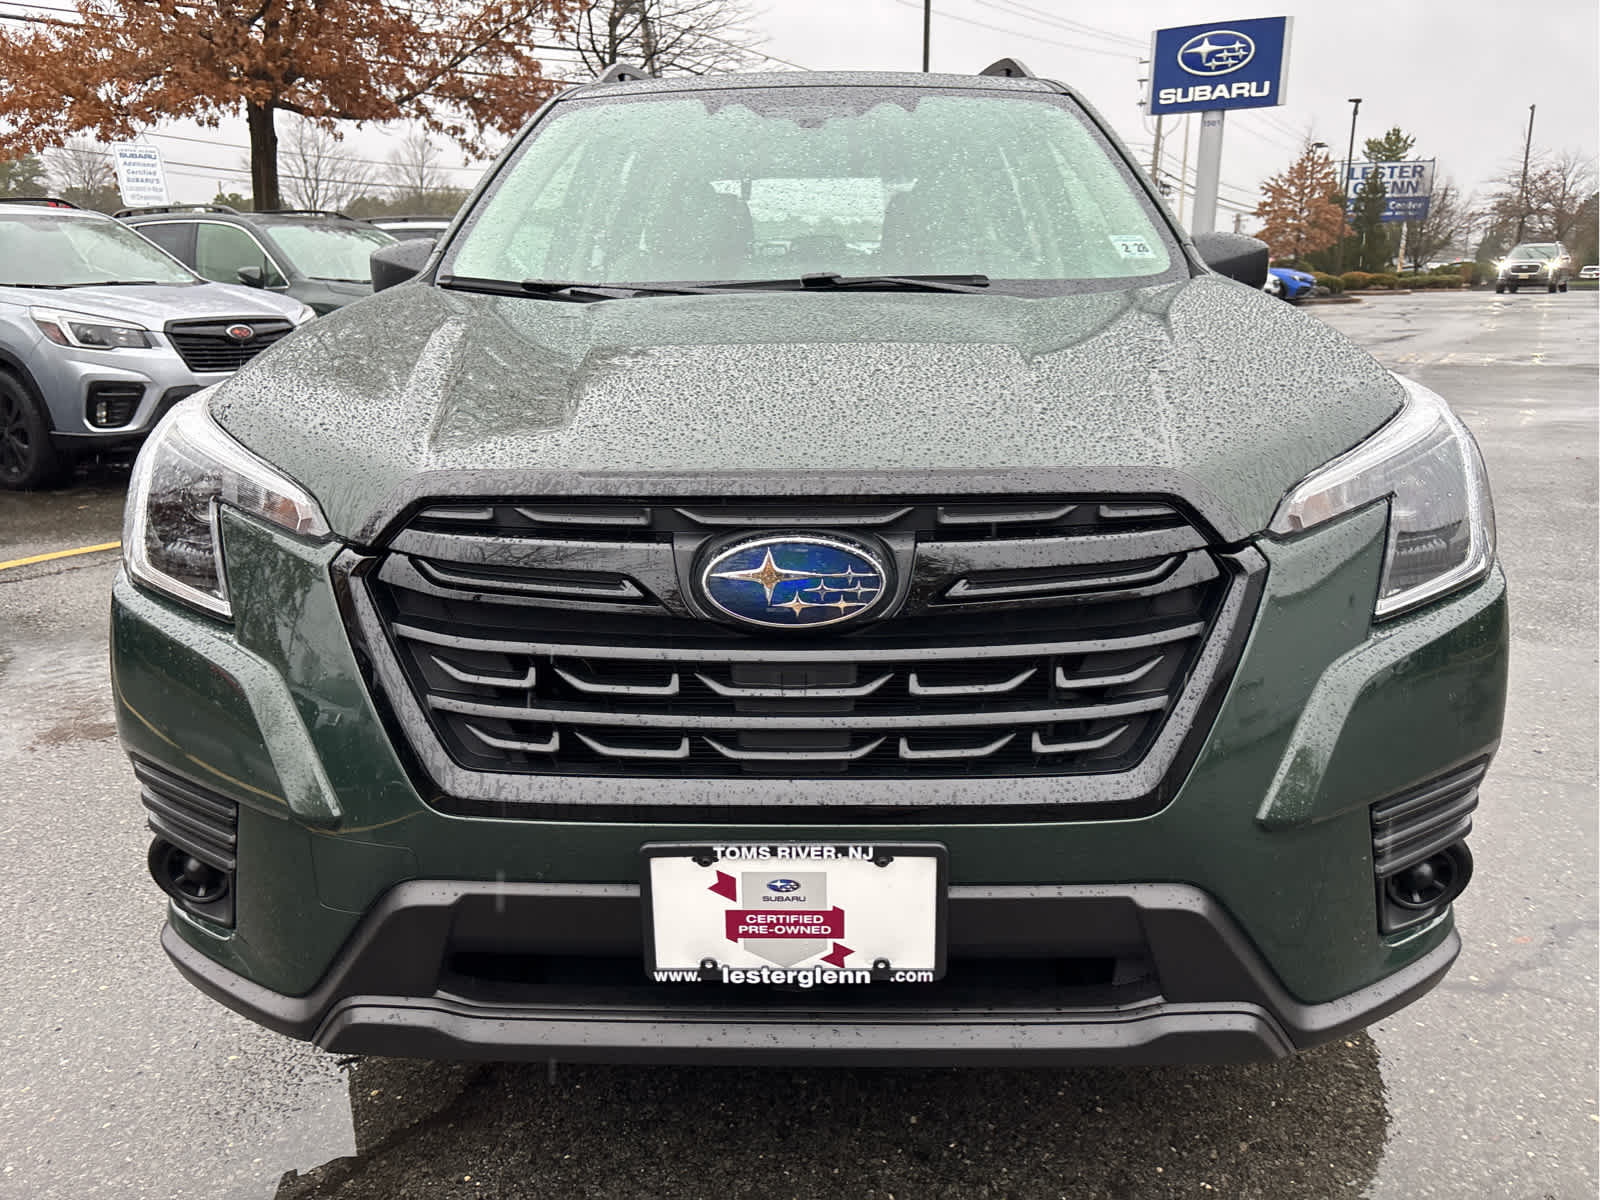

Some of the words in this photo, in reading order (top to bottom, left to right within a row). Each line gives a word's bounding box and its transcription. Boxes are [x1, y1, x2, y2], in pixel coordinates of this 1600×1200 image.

[1159, 81, 1270, 104] SUBARU
[119, 152, 157, 160] SUBARU
[713, 847, 770, 860] TOMS
[777, 847, 842, 860] RIVER,
[848, 847, 874, 860] NJ
[746, 915, 824, 924] CERTIFIED
[738, 925, 832, 934] PRE-OWNED
[653, 971, 701, 982] www.
[722, 966, 871, 988] lesterglenn
[890, 971, 933, 982] .com
